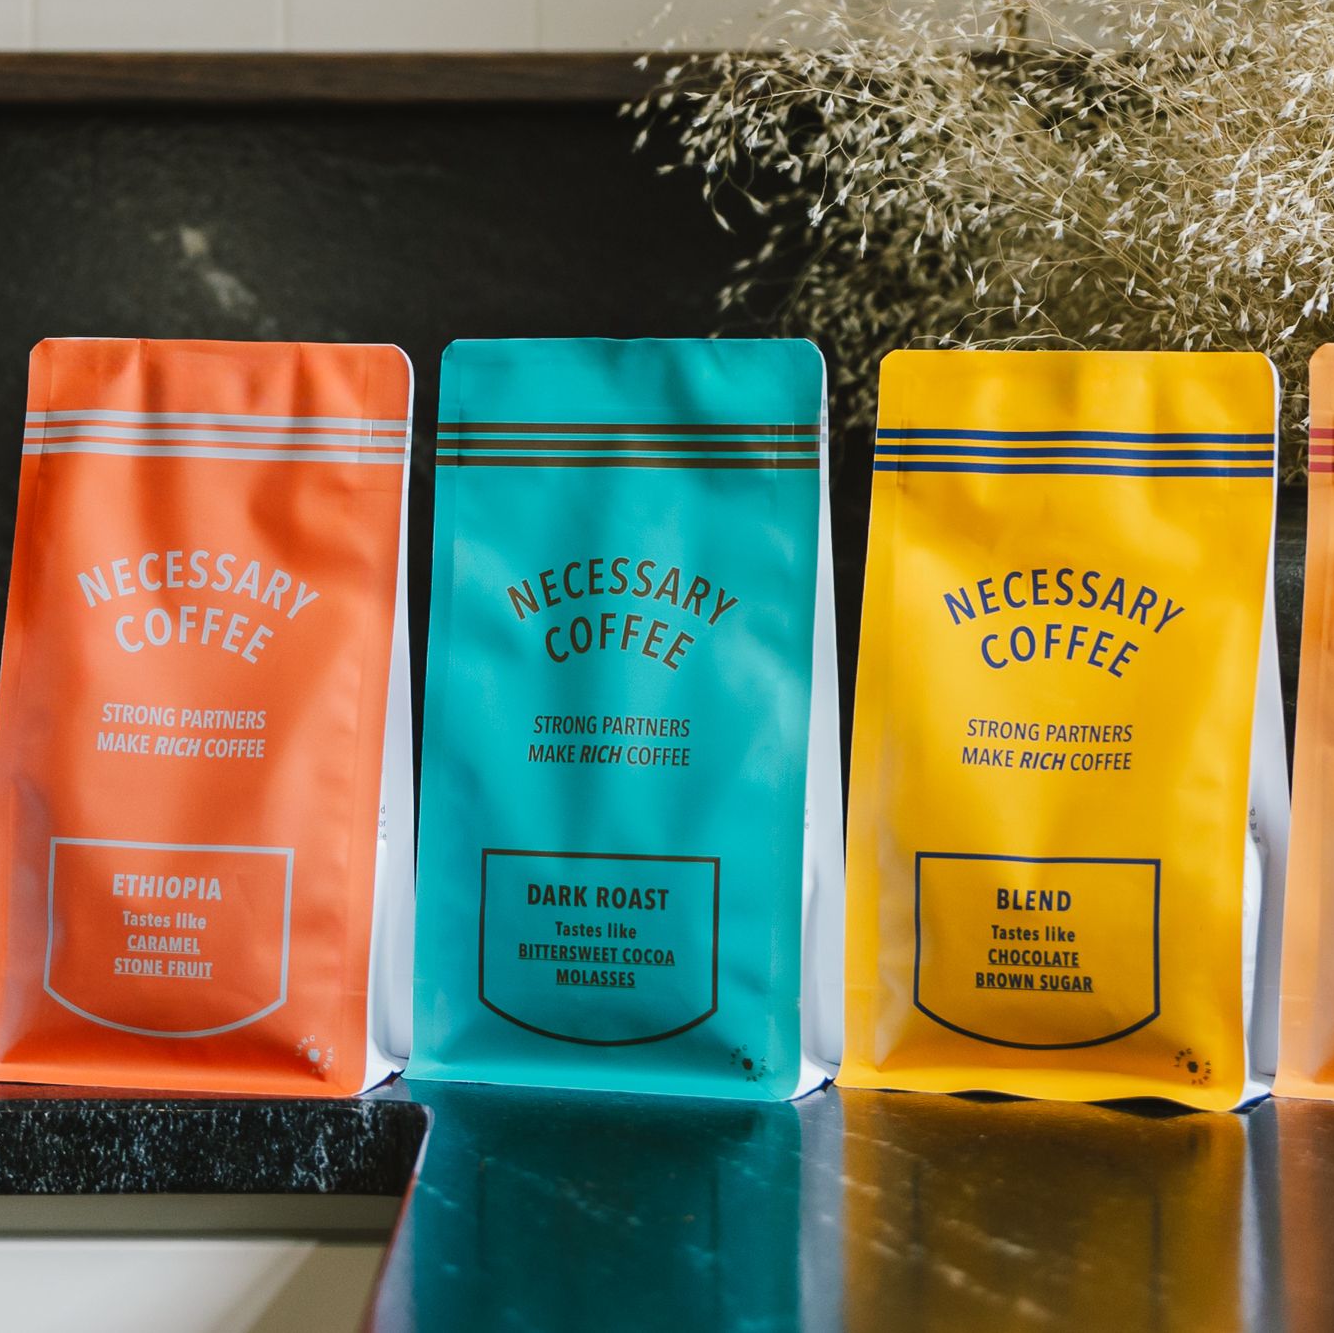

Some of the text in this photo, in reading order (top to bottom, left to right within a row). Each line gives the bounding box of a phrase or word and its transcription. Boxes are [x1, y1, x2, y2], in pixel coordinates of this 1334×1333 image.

[78, 550, 319, 620] NECESSARY
[508, 558, 738, 626] NECESSARY
[944, 568, 1184, 635] NECESSARY
[115, 606, 274, 664] COFFEE
[546, 612, 695, 670] COFFEE
[982, 624, 1138, 677] COFFEE
[102, 704, 266, 730] STRONG PARTNERS
[534, 716, 690, 737] STRONG PARTNERS
[968, 719, 1132, 742] STRONG PARTNERS
[98, 733, 265, 759] MAKE RICH COFFEE
[529, 745, 690, 766] MAKE RICH COFFEE
[963, 747, 1131, 771] MAKE RICH COFFEE
[113, 874, 221, 901] ETHIOPIA
[528, 884, 669, 910] DARK ROAST
[998, 889, 1071, 911] BLEND
[123, 911, 206, 930] Tastes like
[555, 921, 636, 939] Tastes like
[128, 934, 200, 954] CARAMEL
[992, 925, 1075, 942] Tastes like
[519, 943, 675, 966] BITTERSWEET COCOA
[988, 949, 1079, 968] CHOCOLATE
[115, 957, 212, 978] STONE FRUIT
[557, 969, 635, 988] MOLASSES
[976, 972, 1092, 993] BROWN SUGAR
